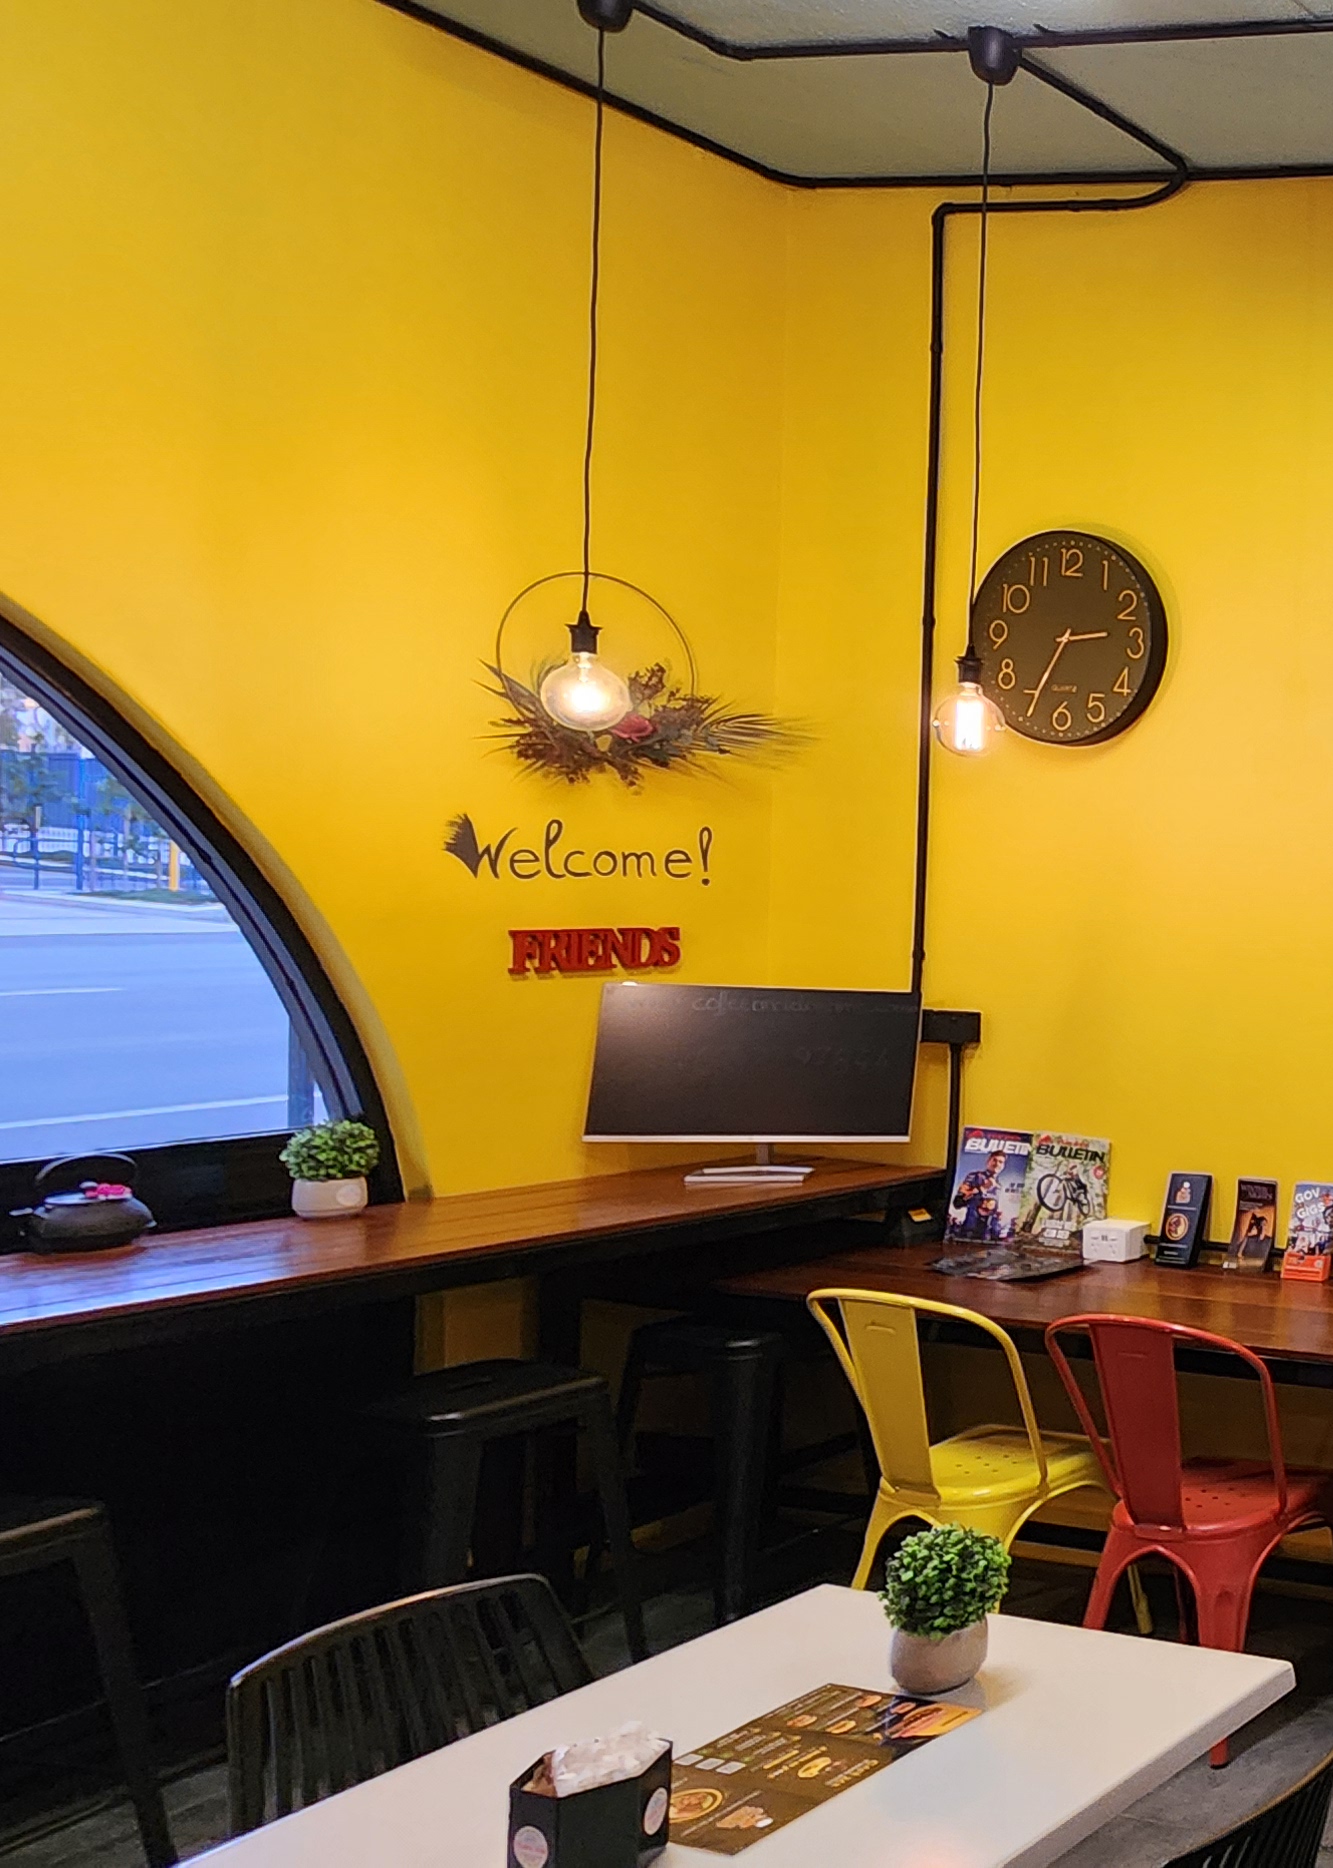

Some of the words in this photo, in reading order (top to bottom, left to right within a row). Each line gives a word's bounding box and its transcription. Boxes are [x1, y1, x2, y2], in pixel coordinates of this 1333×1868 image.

[1029, 556, 1048, 587] 11
[1061, 548, 1084, 577] 12
[1102, 560, 1109, 591] 1
[1002, 583, 1030, 614] 10
[1116, 589, 1138, 620] 2
[989, 619, 1008, 650] 9
[1126, 627, 1144, 659] 3
[998, 658, 1016, 690] 8
[1113, 666, 1132, 697] 4
[1052, 701, 1072, 731] 6
[1086, 693, 1105, 723] 5
[443, 813, 713, 886] Welcome!
[508, 927, 681, 976] FRIENDS
[1036, 1144, 1106, 1162] BULLETIN
[1295, 1187, 1321, 1204] GOV
[1296, 1203, 1326, 1219] GIGS
